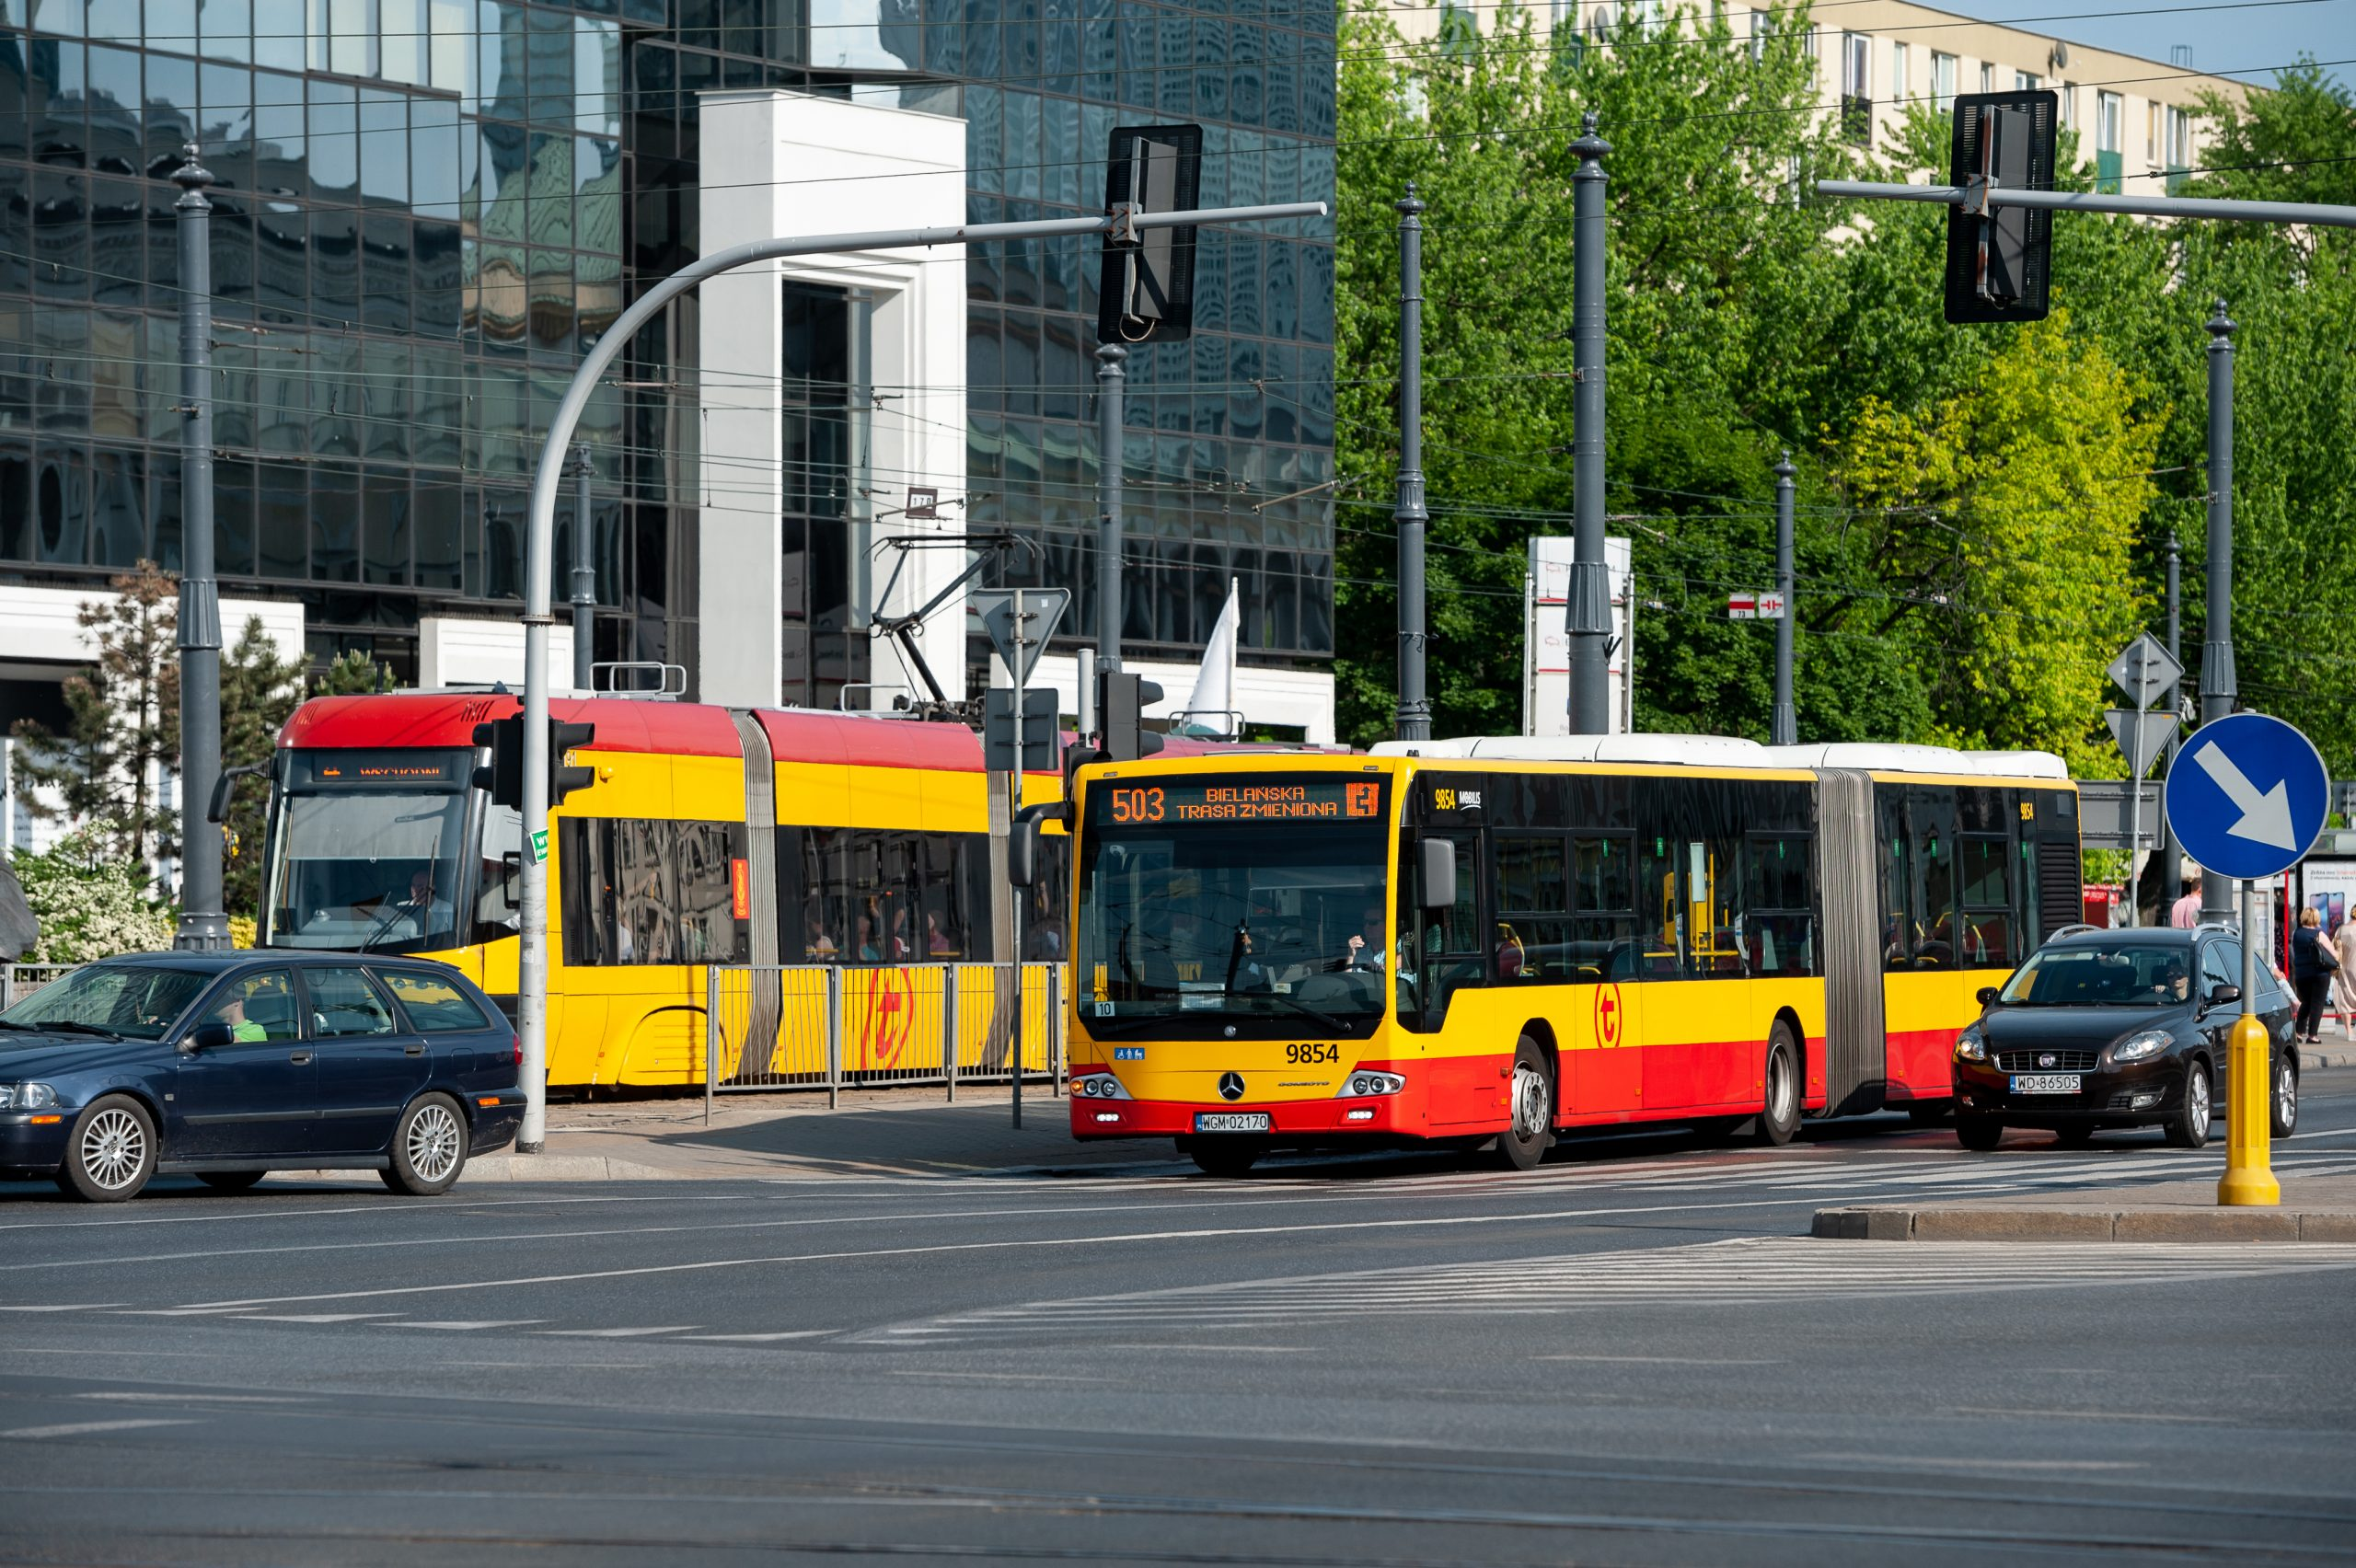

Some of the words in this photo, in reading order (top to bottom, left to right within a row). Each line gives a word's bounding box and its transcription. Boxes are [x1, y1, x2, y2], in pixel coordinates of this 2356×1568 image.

[913, 497, 931, 506] 170
[1206, 786, 1305, 803] BIELAŃSKA
[1435, 789, 1456, 810] 9854
[1459, 790, 1481, 805] MOBILIS
[1112, 787, 1165, 822] 503
[1177, 803, 1236, 819] TRASA
[1240, 801, 1337, 818] ZMIENIONA
[2020, 801, 2034, 820] 9854
[1099, 1003, 1112, 1016] 10
[1286, 1043, 1340, 1065] 9854
[2017, 1077, 2036, 1090] WD
[2039, 1076, 2079, 1090] 86505
[1202, 1115, 1226, 1129] WGM
[1230, 1115, 1267, 1129] 02170
